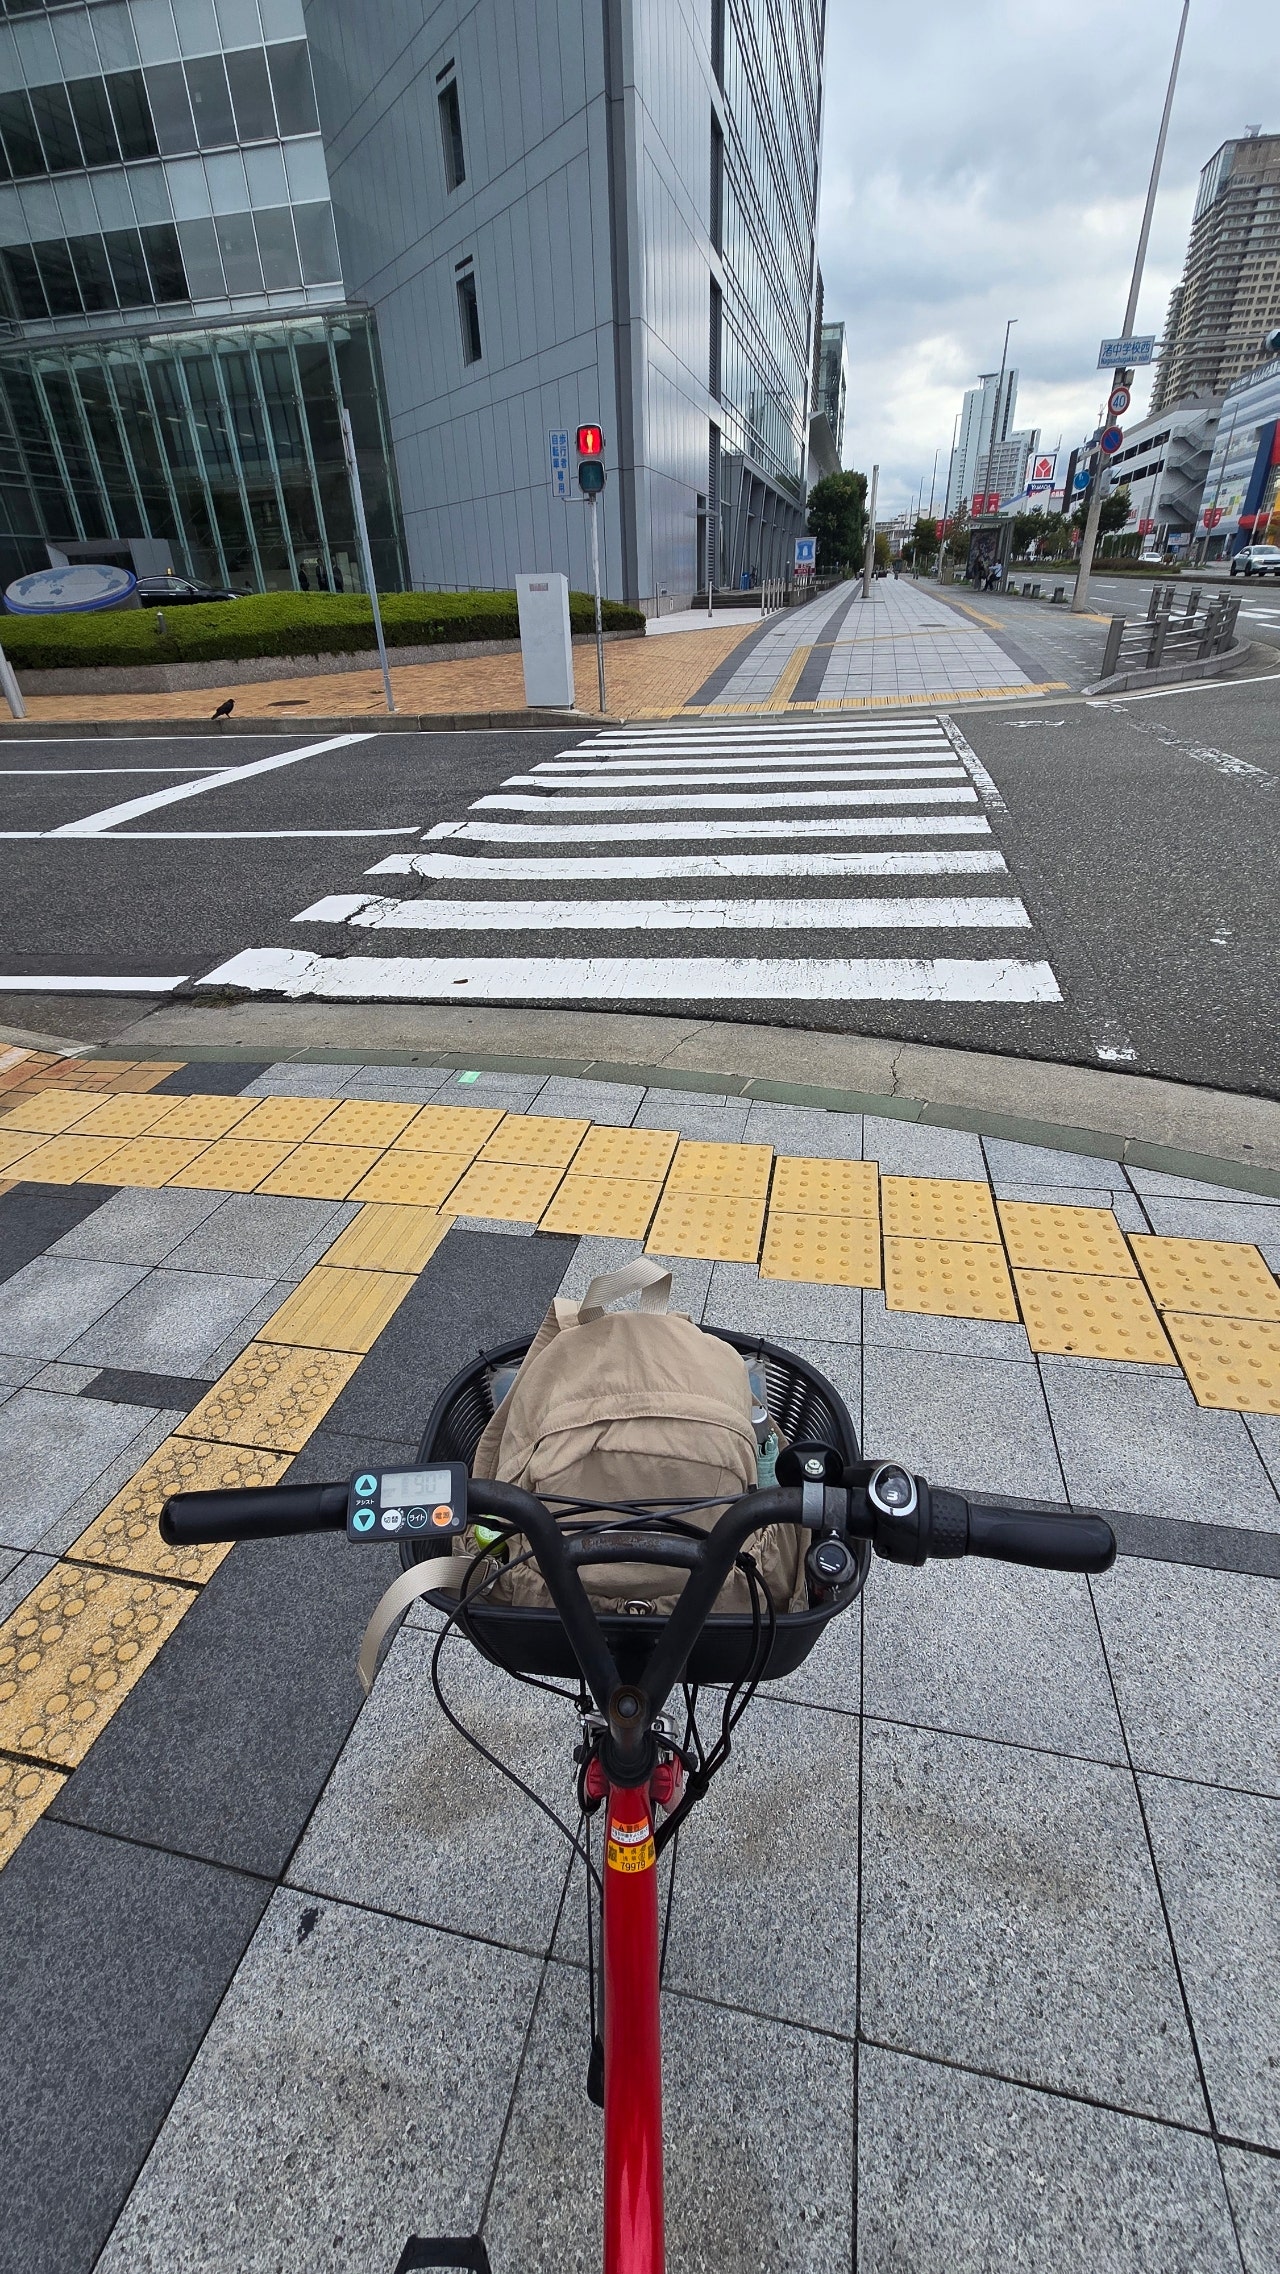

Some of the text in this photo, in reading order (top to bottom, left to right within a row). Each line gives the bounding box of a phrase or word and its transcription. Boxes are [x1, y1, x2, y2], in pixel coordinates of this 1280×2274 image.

[1103, 341, 1151, 356] 渚中学校西
[1113, 395, 1126, 408] 40
[551, 434, 560, 469] 自転車
[559, 434, 568, 469] 歩行者
[557, 471, 565, 494] 専用
[886, 1490, 898, 1501] 3
[384, 1516, 399, 1525] 切替
[409, 1513, 426, 1522] ライト
[435, 1511, 450, 1520] 電源
[620, 1860, 646, 1872] 79979
